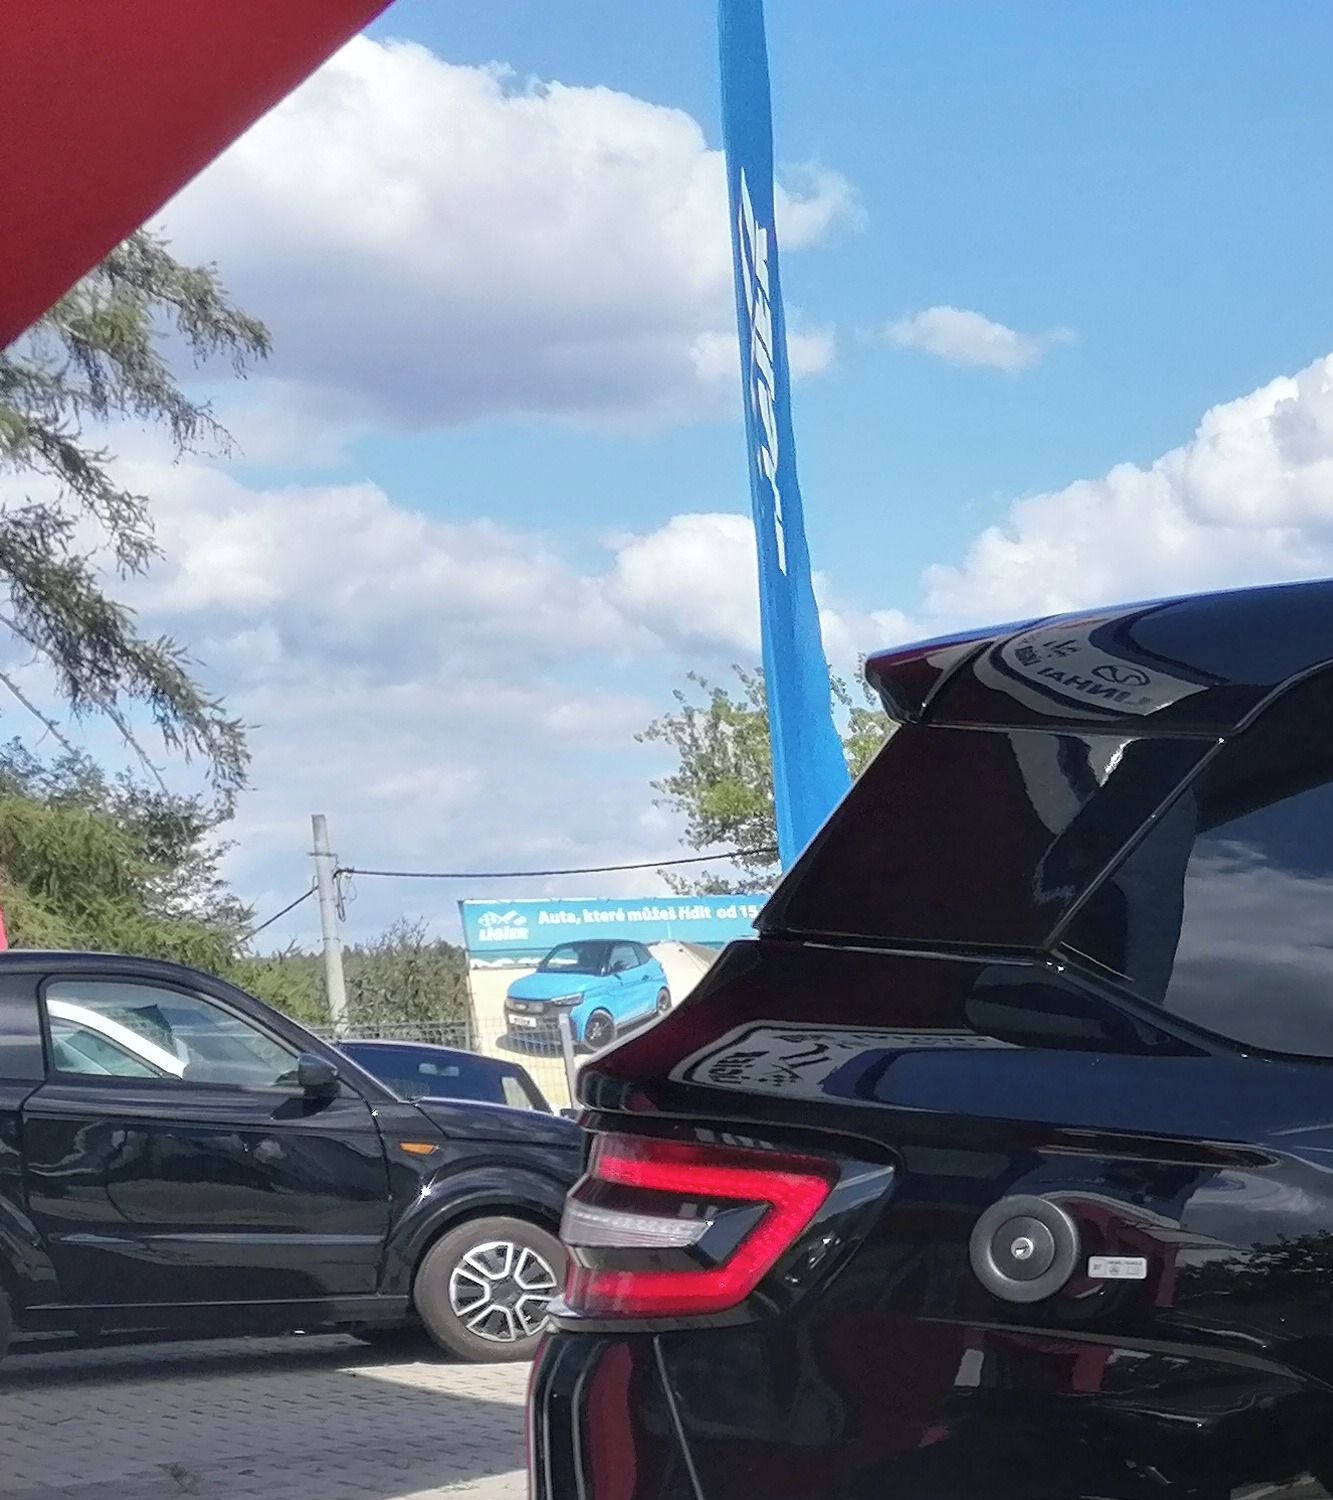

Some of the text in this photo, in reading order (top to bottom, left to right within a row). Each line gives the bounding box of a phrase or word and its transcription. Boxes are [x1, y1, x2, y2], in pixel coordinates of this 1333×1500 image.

[538, 910, 581, 925] Auta,
[582, 907, 625, 923] které
[627, 906, 677, 922] můžeš
[716, 905, 738, 919] od
